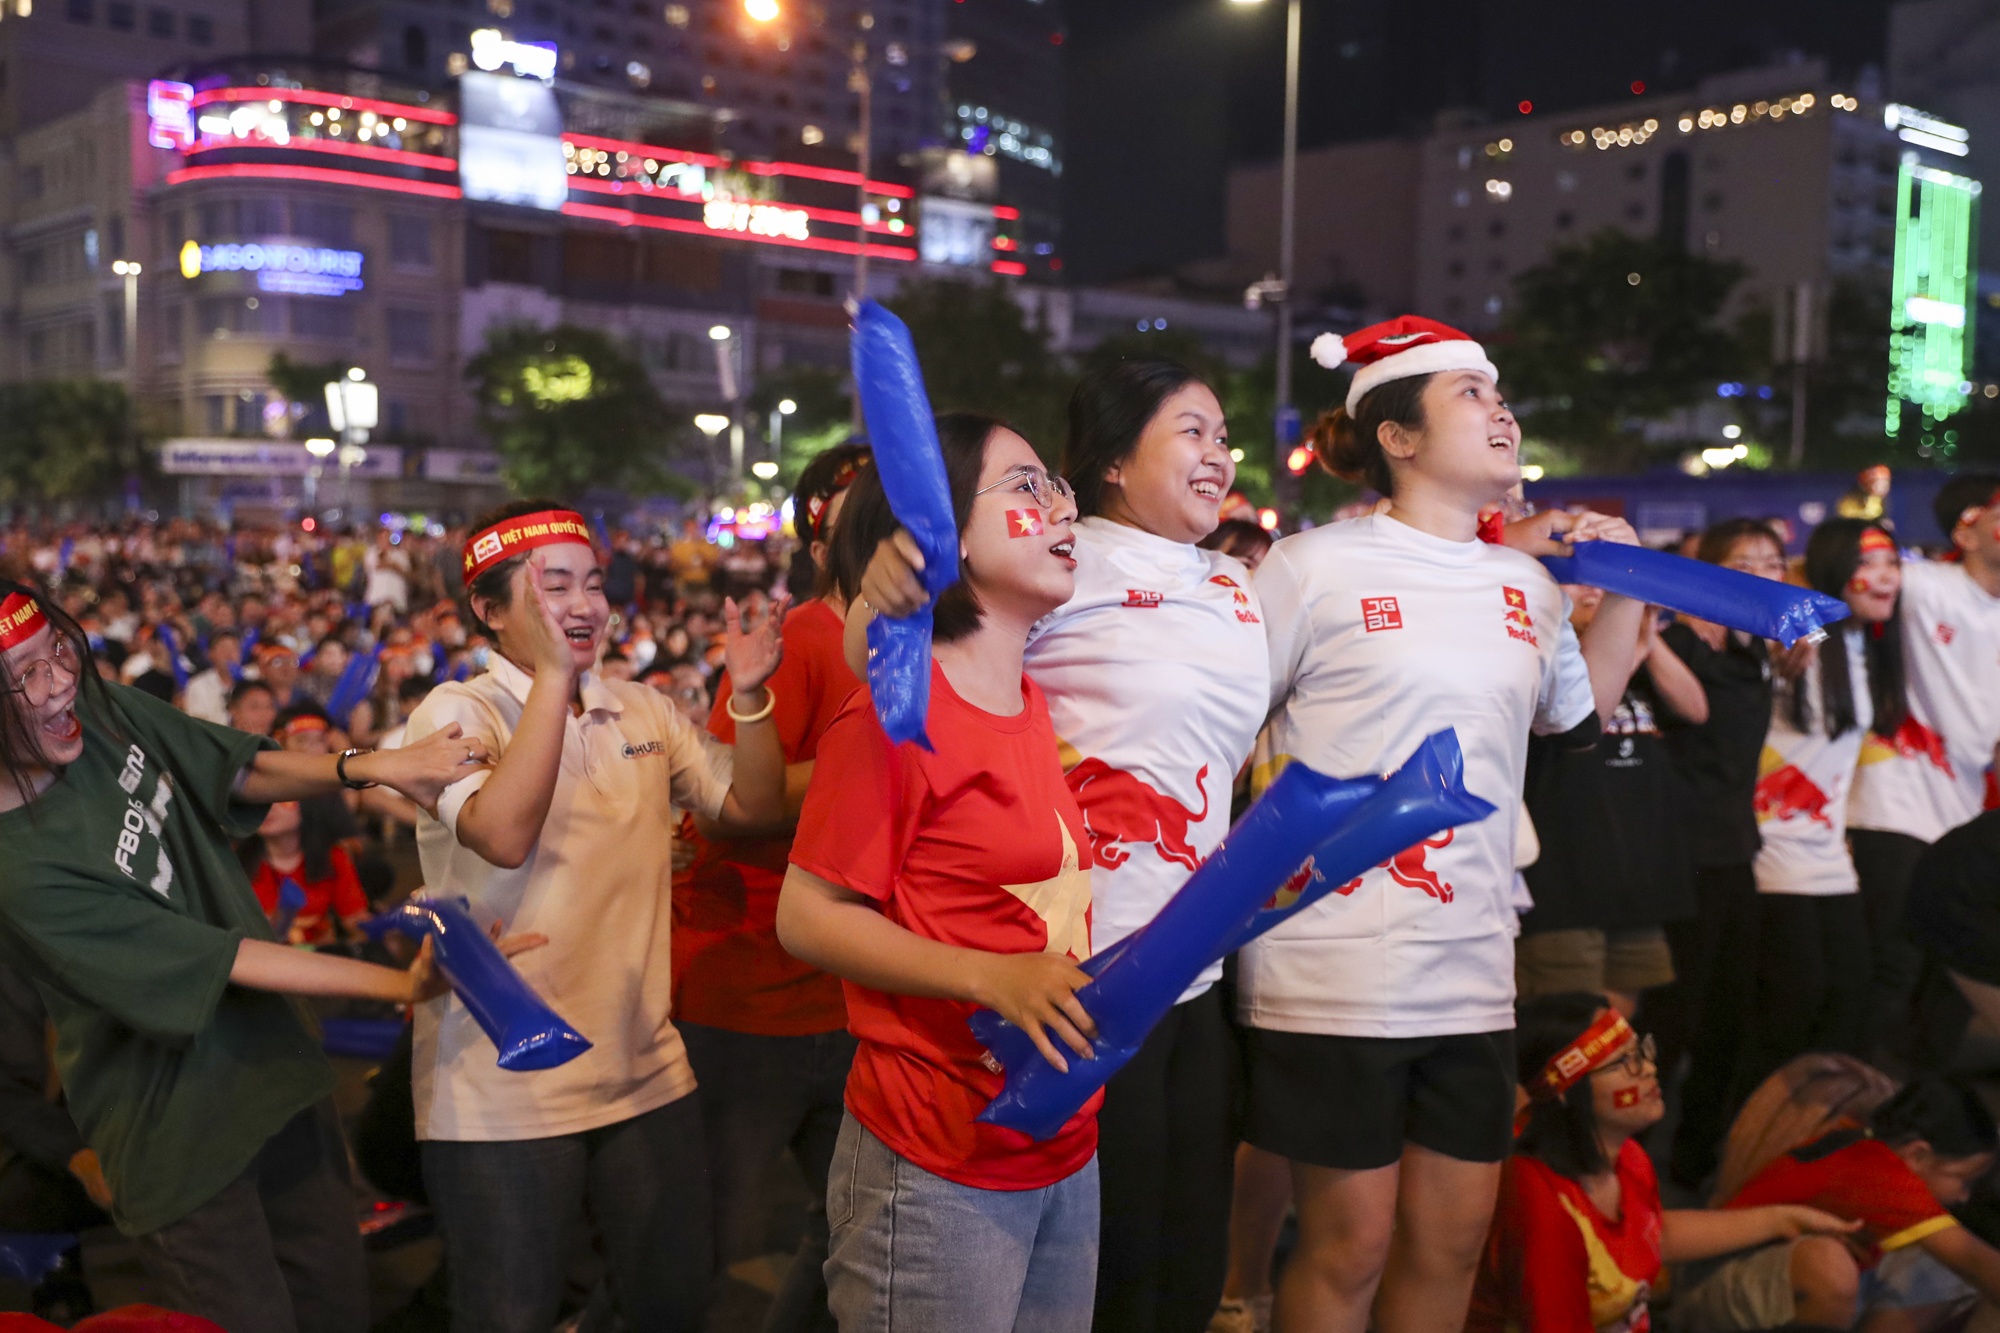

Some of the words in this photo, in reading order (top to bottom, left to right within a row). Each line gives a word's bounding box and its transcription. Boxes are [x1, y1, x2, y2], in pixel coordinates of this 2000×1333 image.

[501, 529, 523, 545] VIỆT
[524, 524, 549, 538] NAM
[550, 520, 577, 535] QUYẾT
[11, 603, 34, 627] NAM
[1367, 613, 1399, 629] BL
